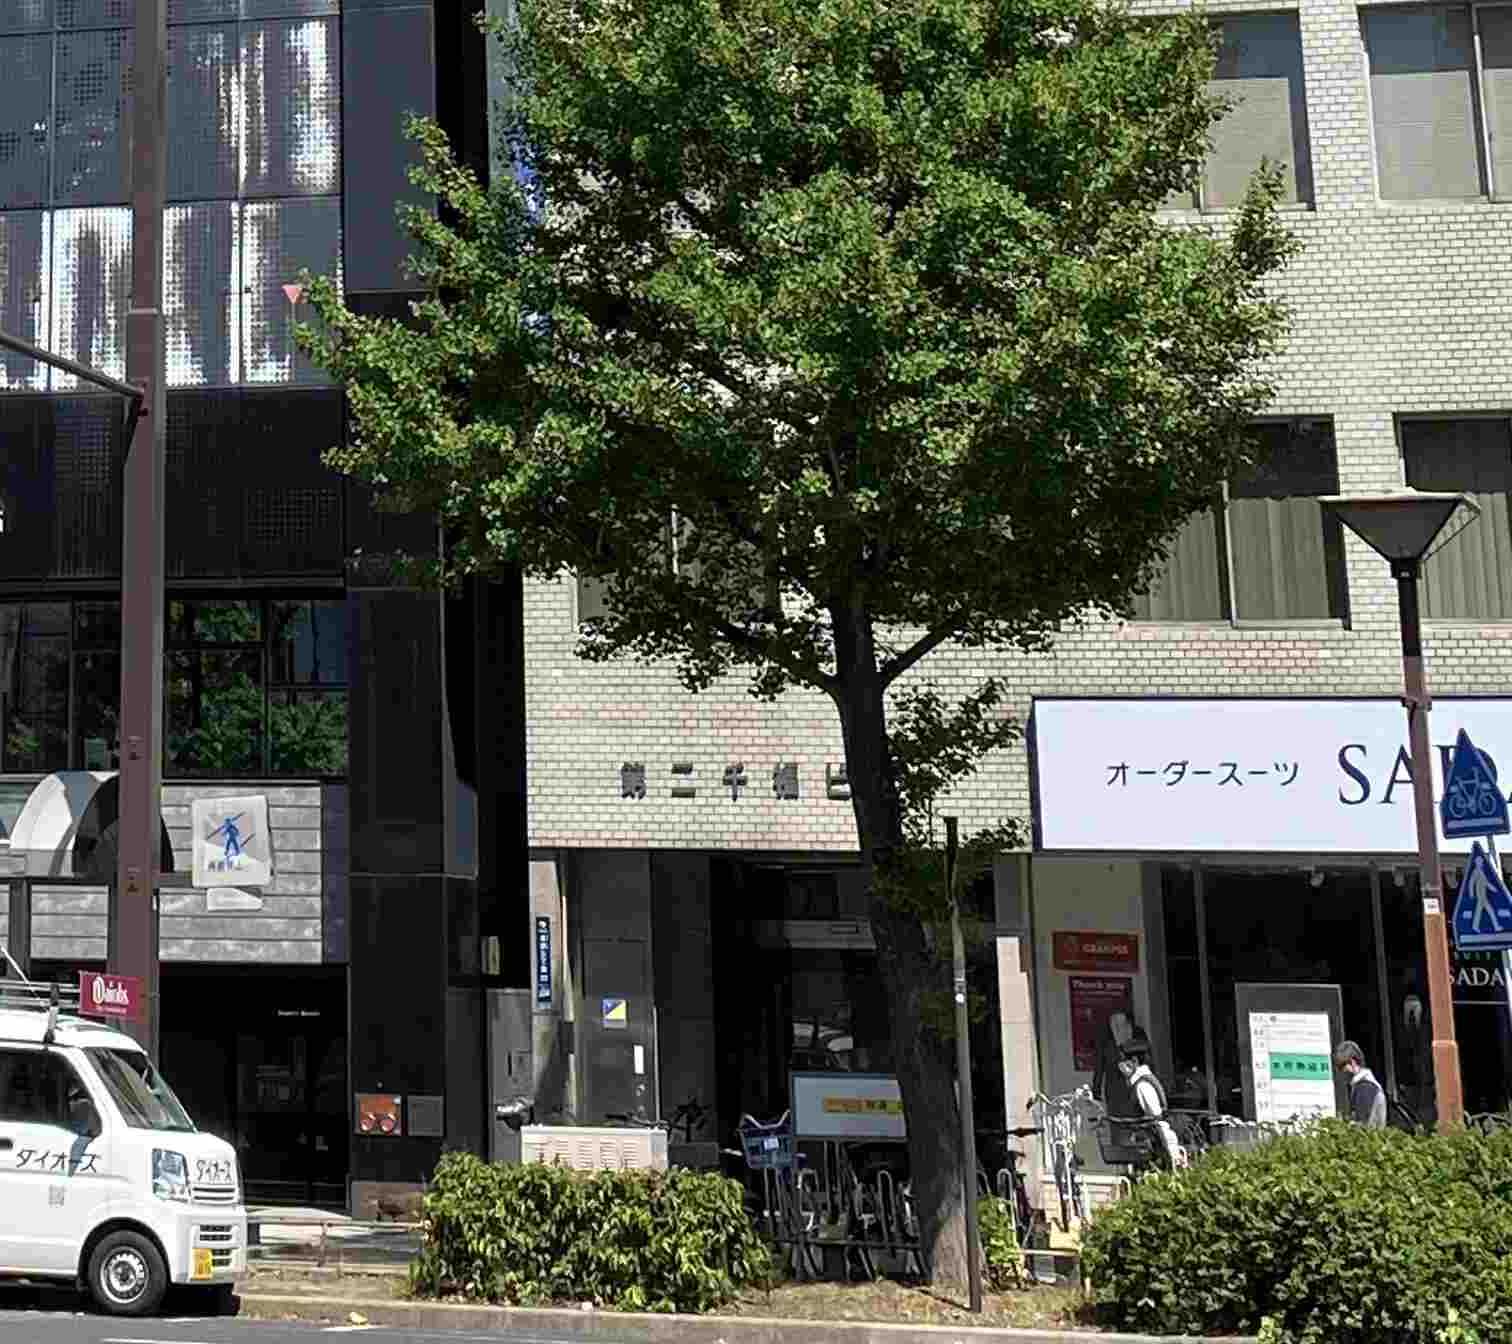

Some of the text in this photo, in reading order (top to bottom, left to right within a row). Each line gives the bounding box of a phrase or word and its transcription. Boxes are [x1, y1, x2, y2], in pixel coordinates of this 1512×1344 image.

[1106, 761, 1299, 787] オーダースーツ
[1338, 744, 1512, 805] SA
